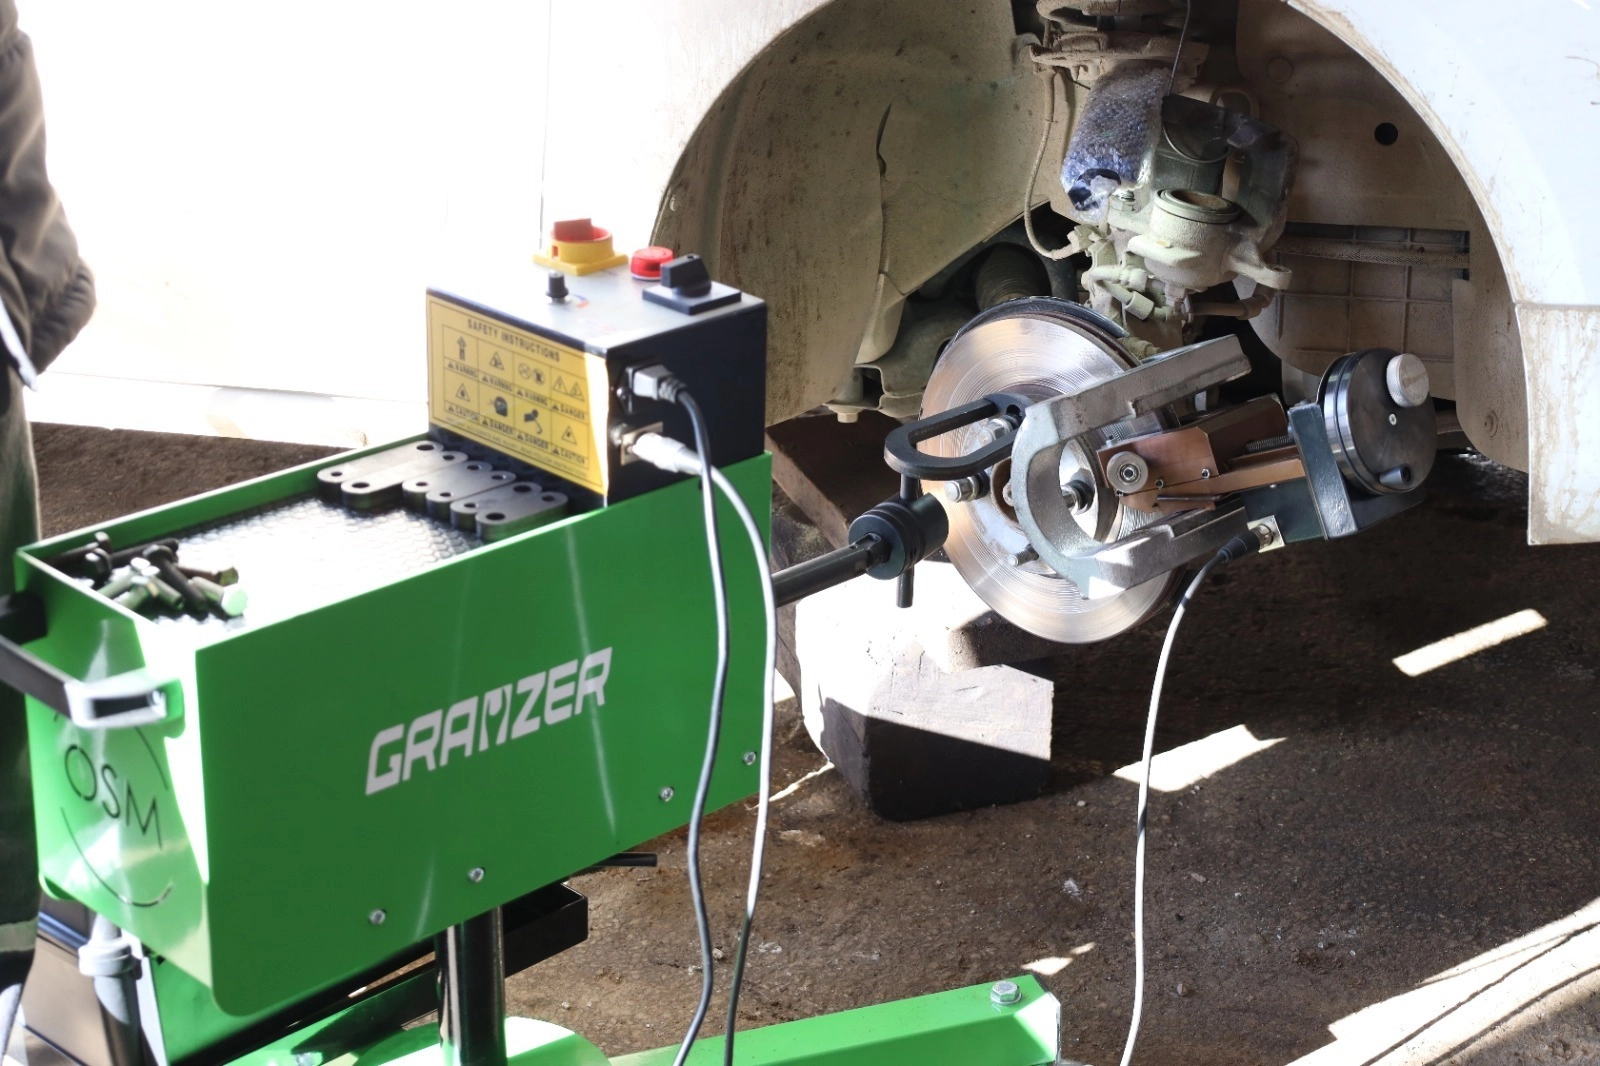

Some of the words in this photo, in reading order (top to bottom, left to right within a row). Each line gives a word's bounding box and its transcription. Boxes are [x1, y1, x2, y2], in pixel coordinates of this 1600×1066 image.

[467, 318, 499, 338] SAFETY
[501, 331, 560, 362] INSTRUCTIONS
[455, 404, 480, 422] CAUTION
[560, 402, 585, 419] DANGER
[490, 417, 514, 434] DANGER
[525, 433, 549, 450] DANGER
[560, 448, 586, 465] CAUTION
[365, 646, 613, 796] GRANZER
[64, 744, 163, 850] OSM
